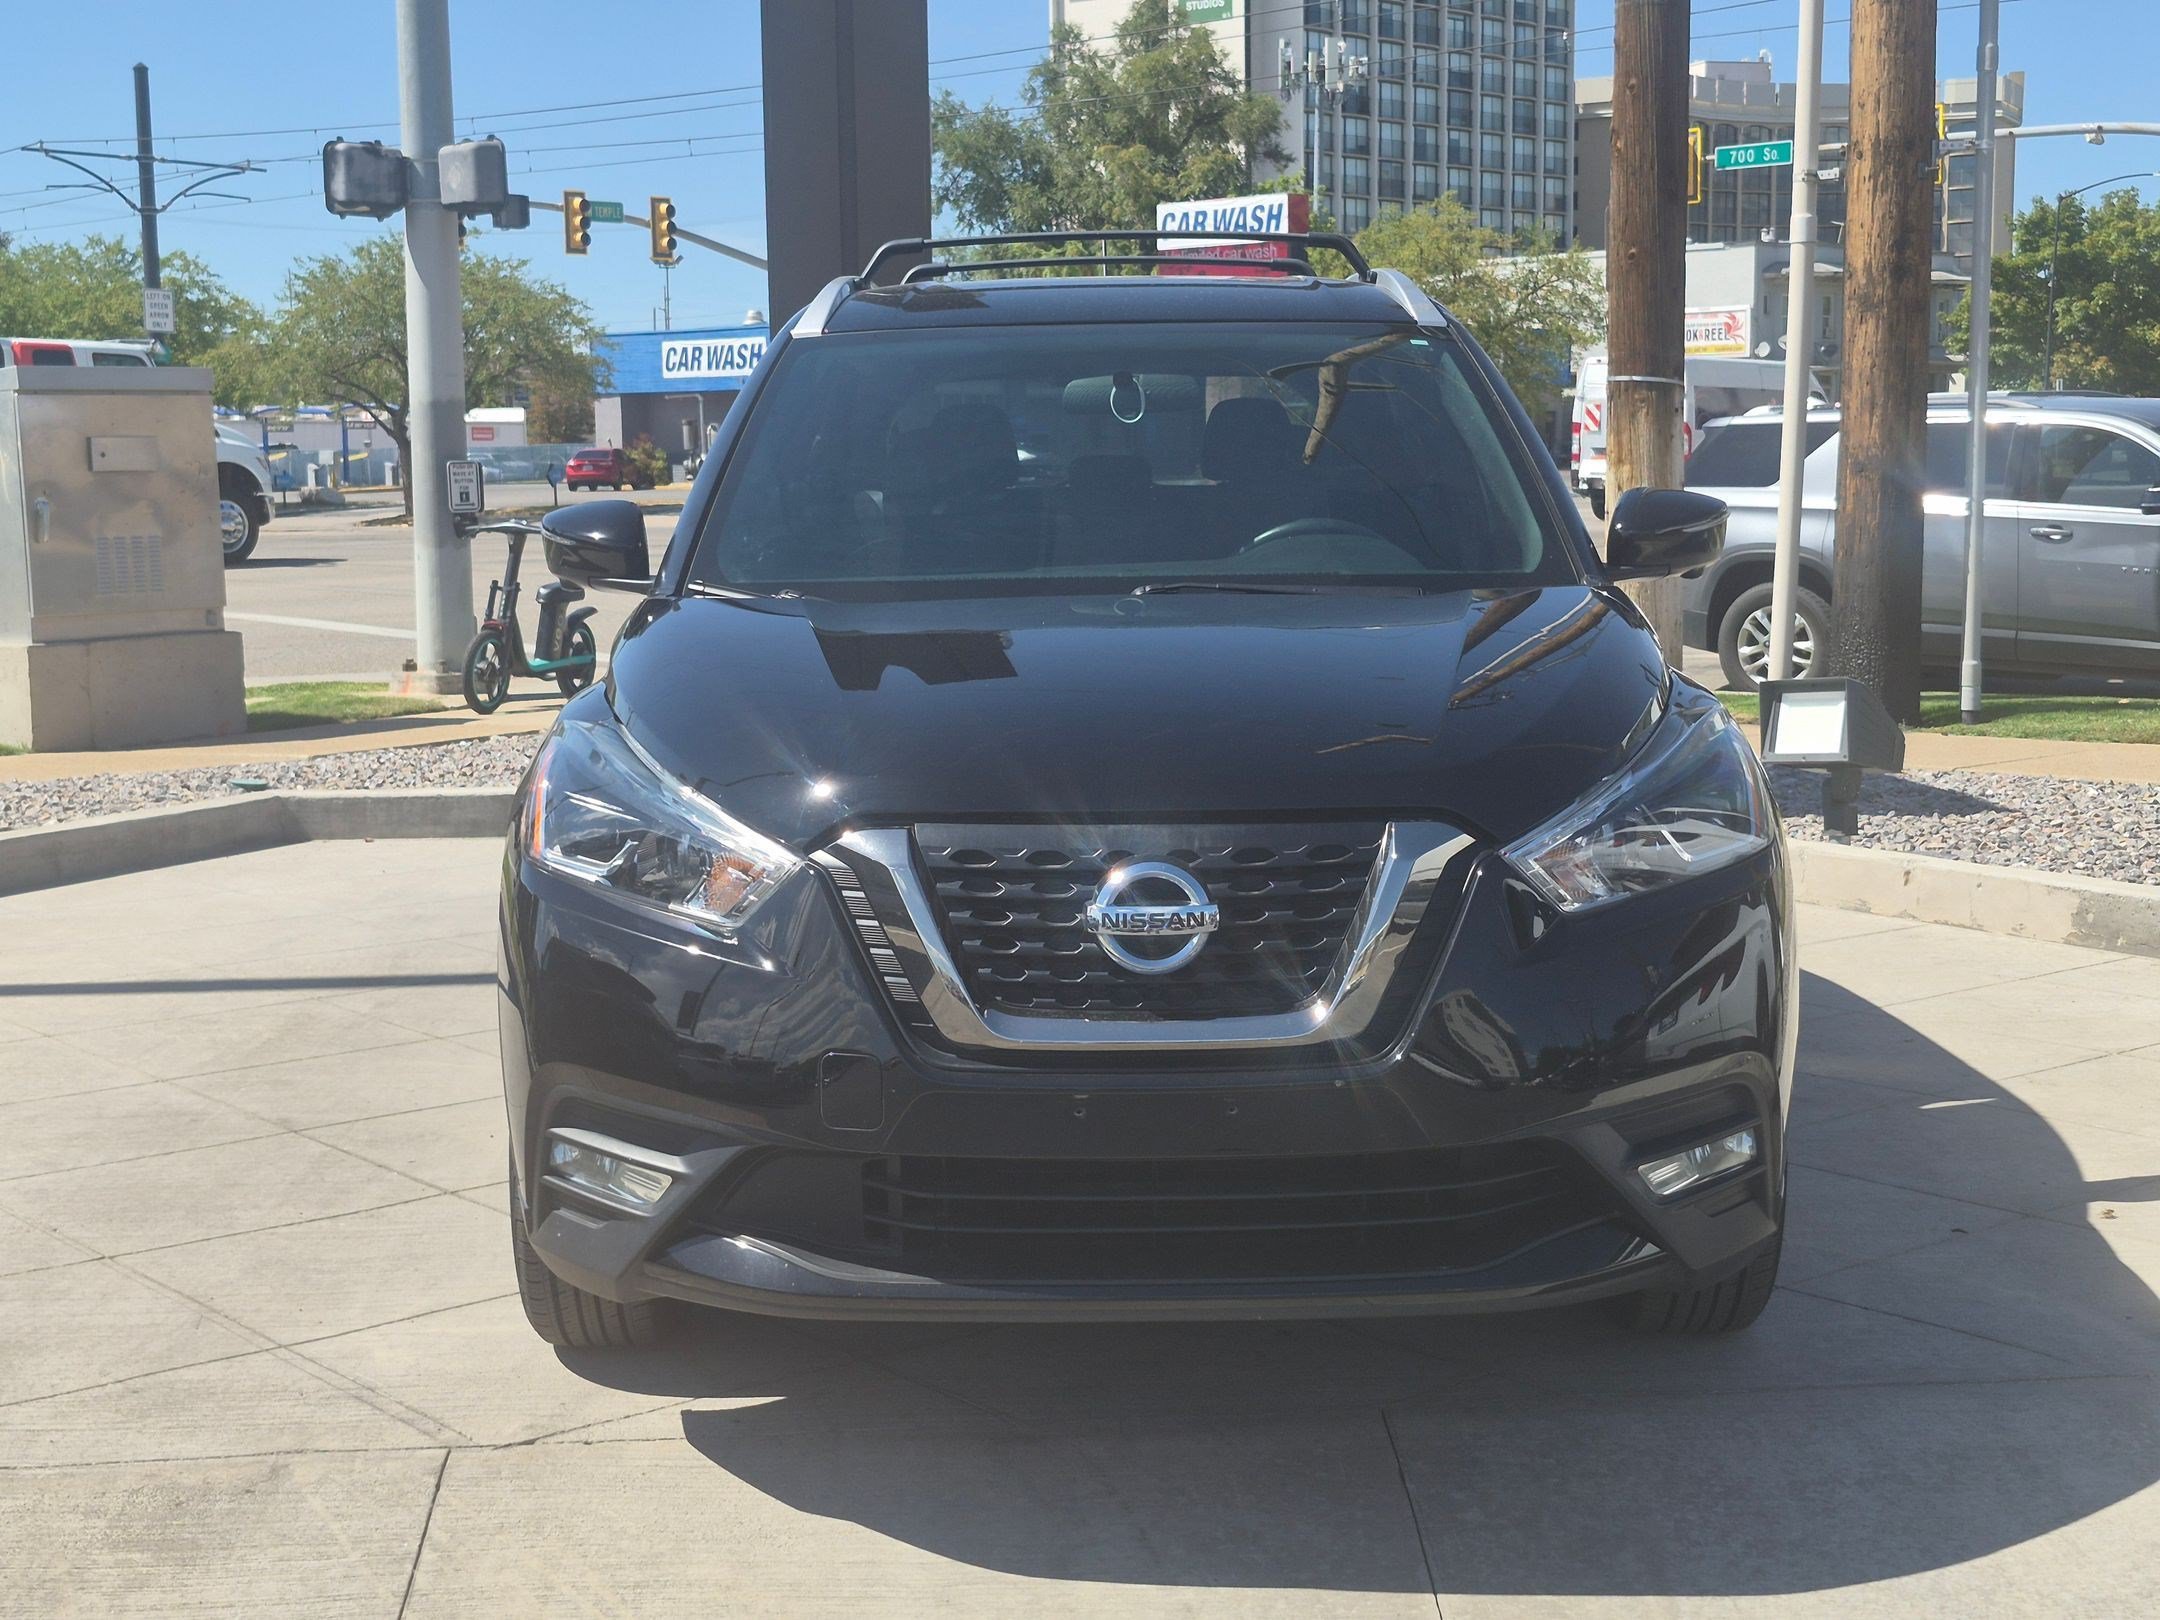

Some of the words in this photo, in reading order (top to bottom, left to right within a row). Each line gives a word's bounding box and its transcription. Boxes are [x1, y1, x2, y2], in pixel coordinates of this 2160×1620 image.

[1186, 0, 1225, 11] STUDIOS
[1729, 149, 1755, 164] 700
[594, 206, 621, 219] TEMPLE
[1161, 210, 1208, 232] CAR
[1213, 203, 1284, 233] WASH
[1245, 243, 1278, 259] wash
[152, 320, 167, 329] ONLY
[665, 346, 703, 372] CAR
[706, 343, 763, 371] WASH
[1101, 911, 1205, 930] NISSAN
